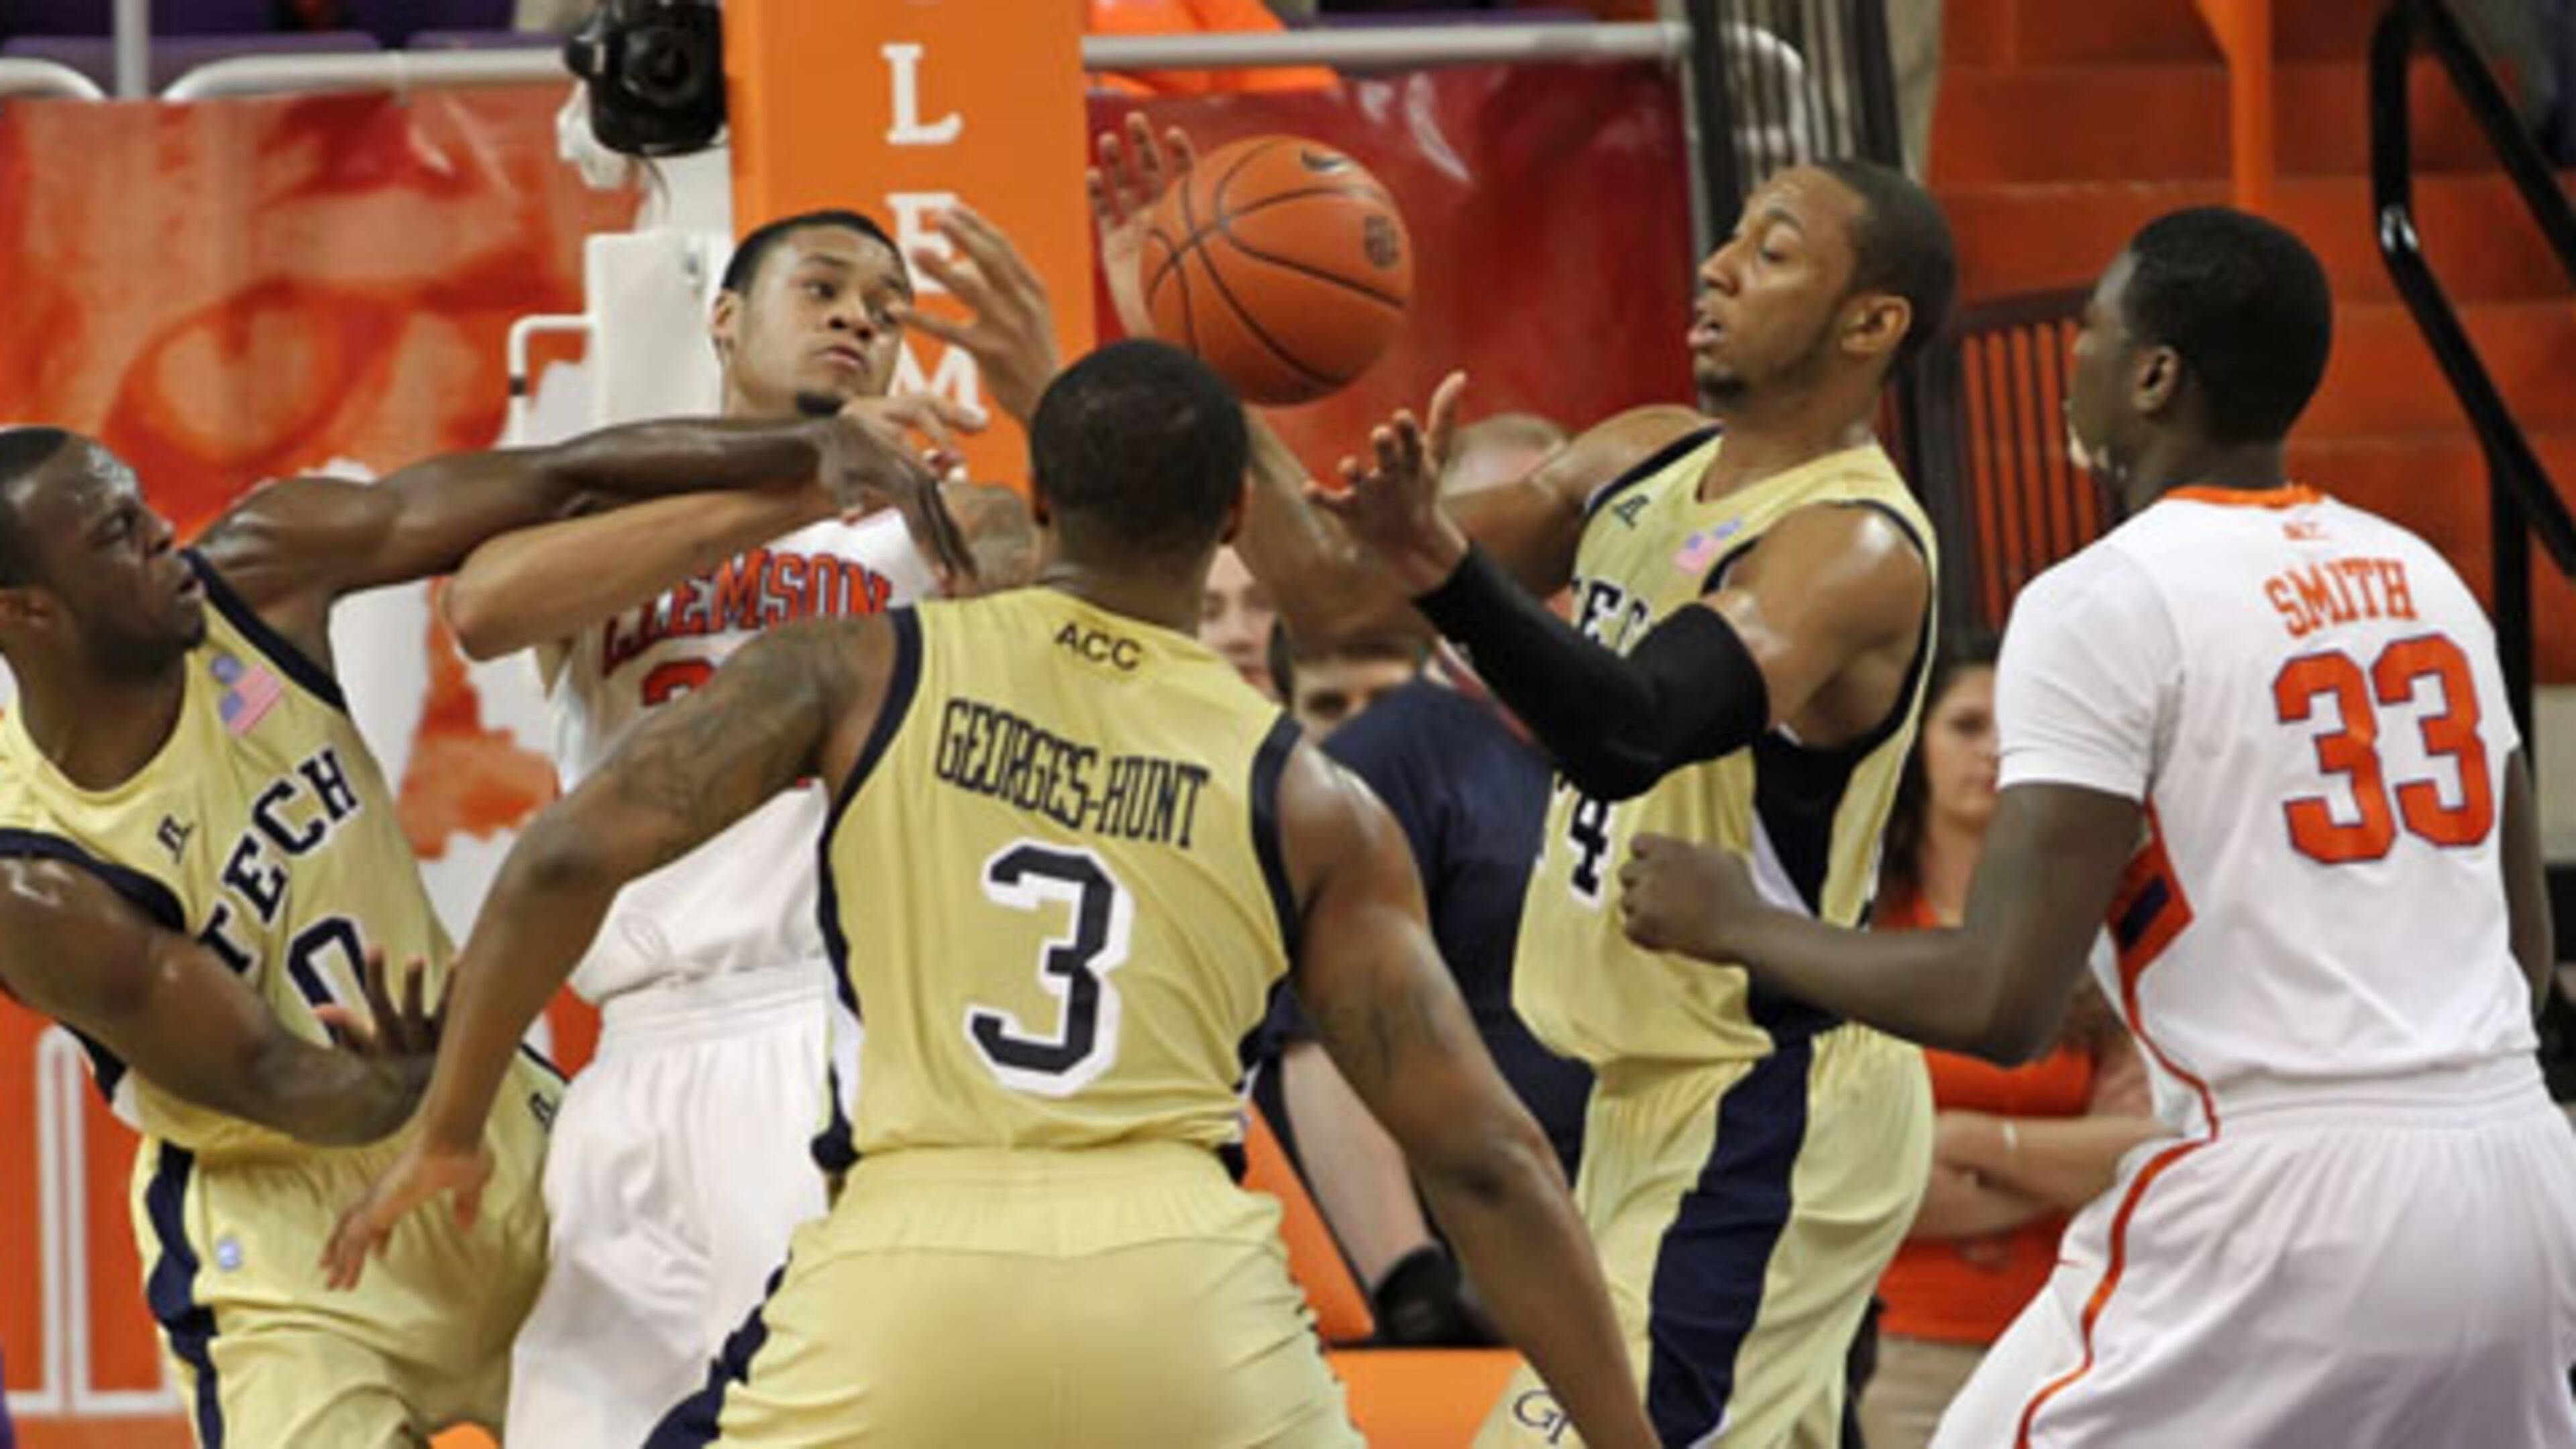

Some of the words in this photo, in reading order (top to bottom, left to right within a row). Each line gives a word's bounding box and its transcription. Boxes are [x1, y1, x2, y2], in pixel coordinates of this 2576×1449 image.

[1053, 621, 1142, 671] ACC
[2263, 557, 2418, 639] SMITH
[936, 697, 1212, 851] GEORGES-HUNT
[2271, 632, 2496, 865] 33
[199, 748, 360, 976] TECH
[286, 916, 373, 1046] 0
[966, 837, 1132, 1097] 3
